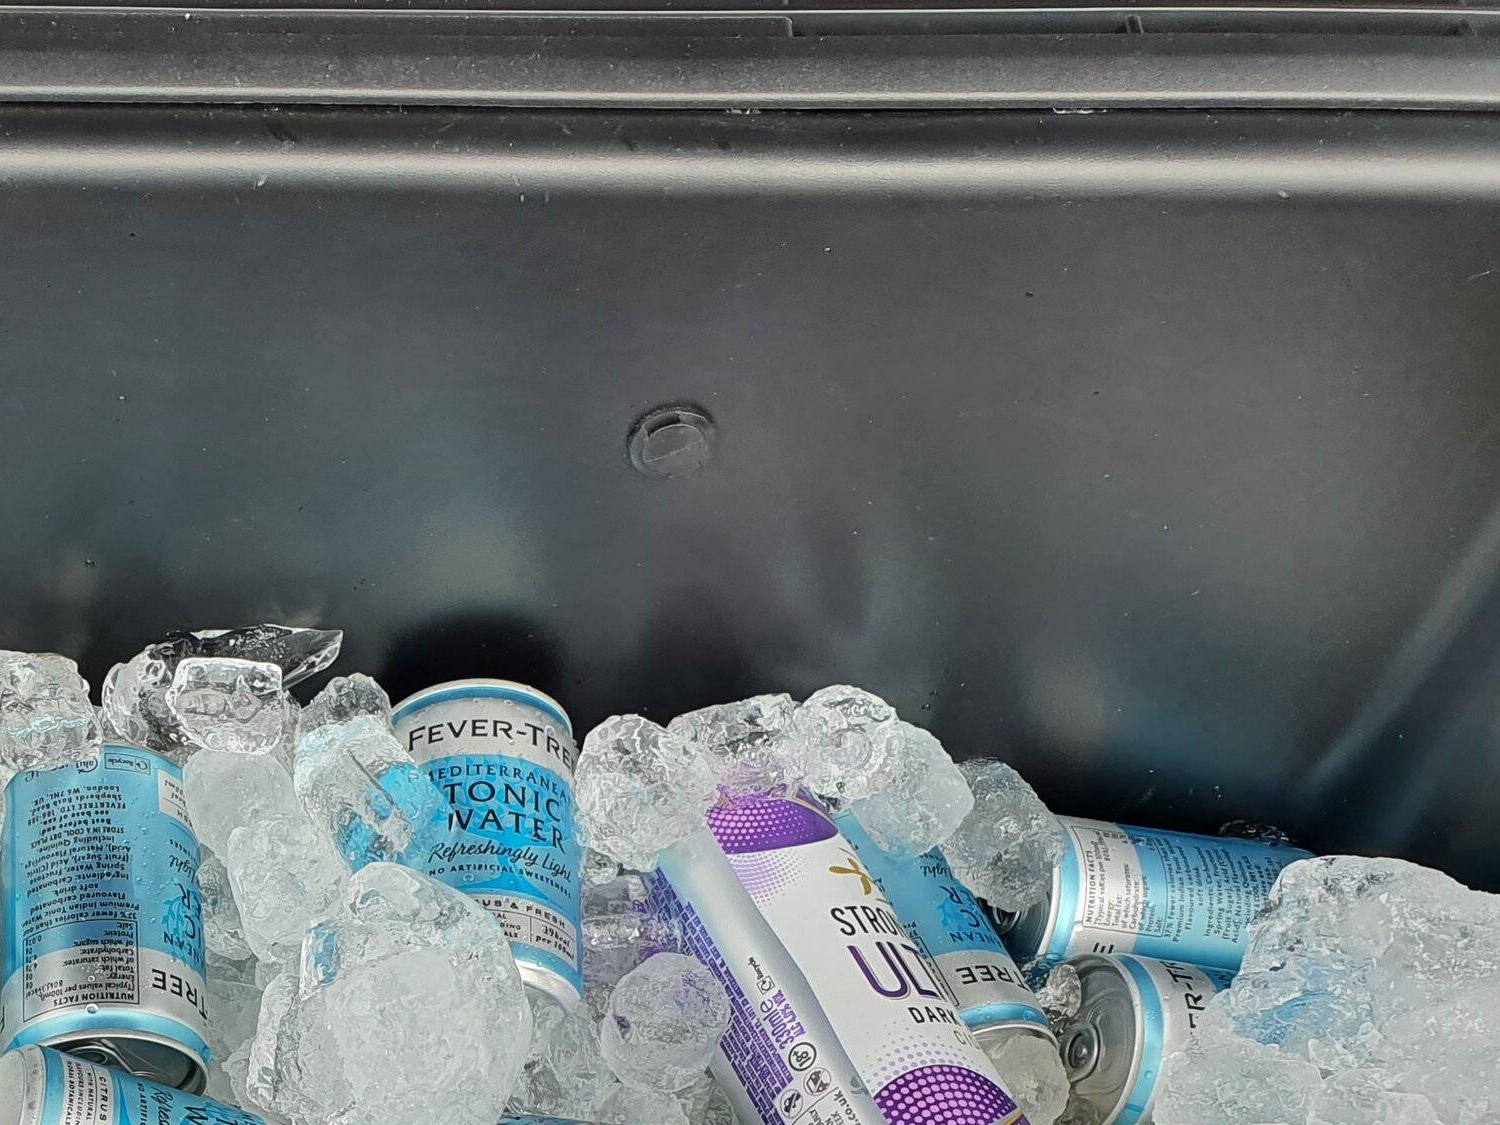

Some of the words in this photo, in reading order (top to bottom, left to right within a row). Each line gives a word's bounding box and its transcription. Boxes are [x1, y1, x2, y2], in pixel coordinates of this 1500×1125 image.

[444, 781, 560, 822] TONIC
[428, 840, 538, 866] Refreshingly
[429, 868, 445, 876] NO
[450, 864, 514, 873] ARTIFICIAL
[30, 895, 77, 913] carbonated
[69, 901, 97, 910] Indian
[100, 901, 139, 910] Premium
[1086, 874, 1096, 923] NUTRITION
[45, 906, 66, 917] Tonic
[526, 906, 565, 928] FRESH
[54, 994, 78, 1006] FACTS
[65, 1081, 75, 1125] BOTANICALS
[86, 1088, 94, 1121] NATURAL
[99, 1076, 108, 1122] CITRUS
